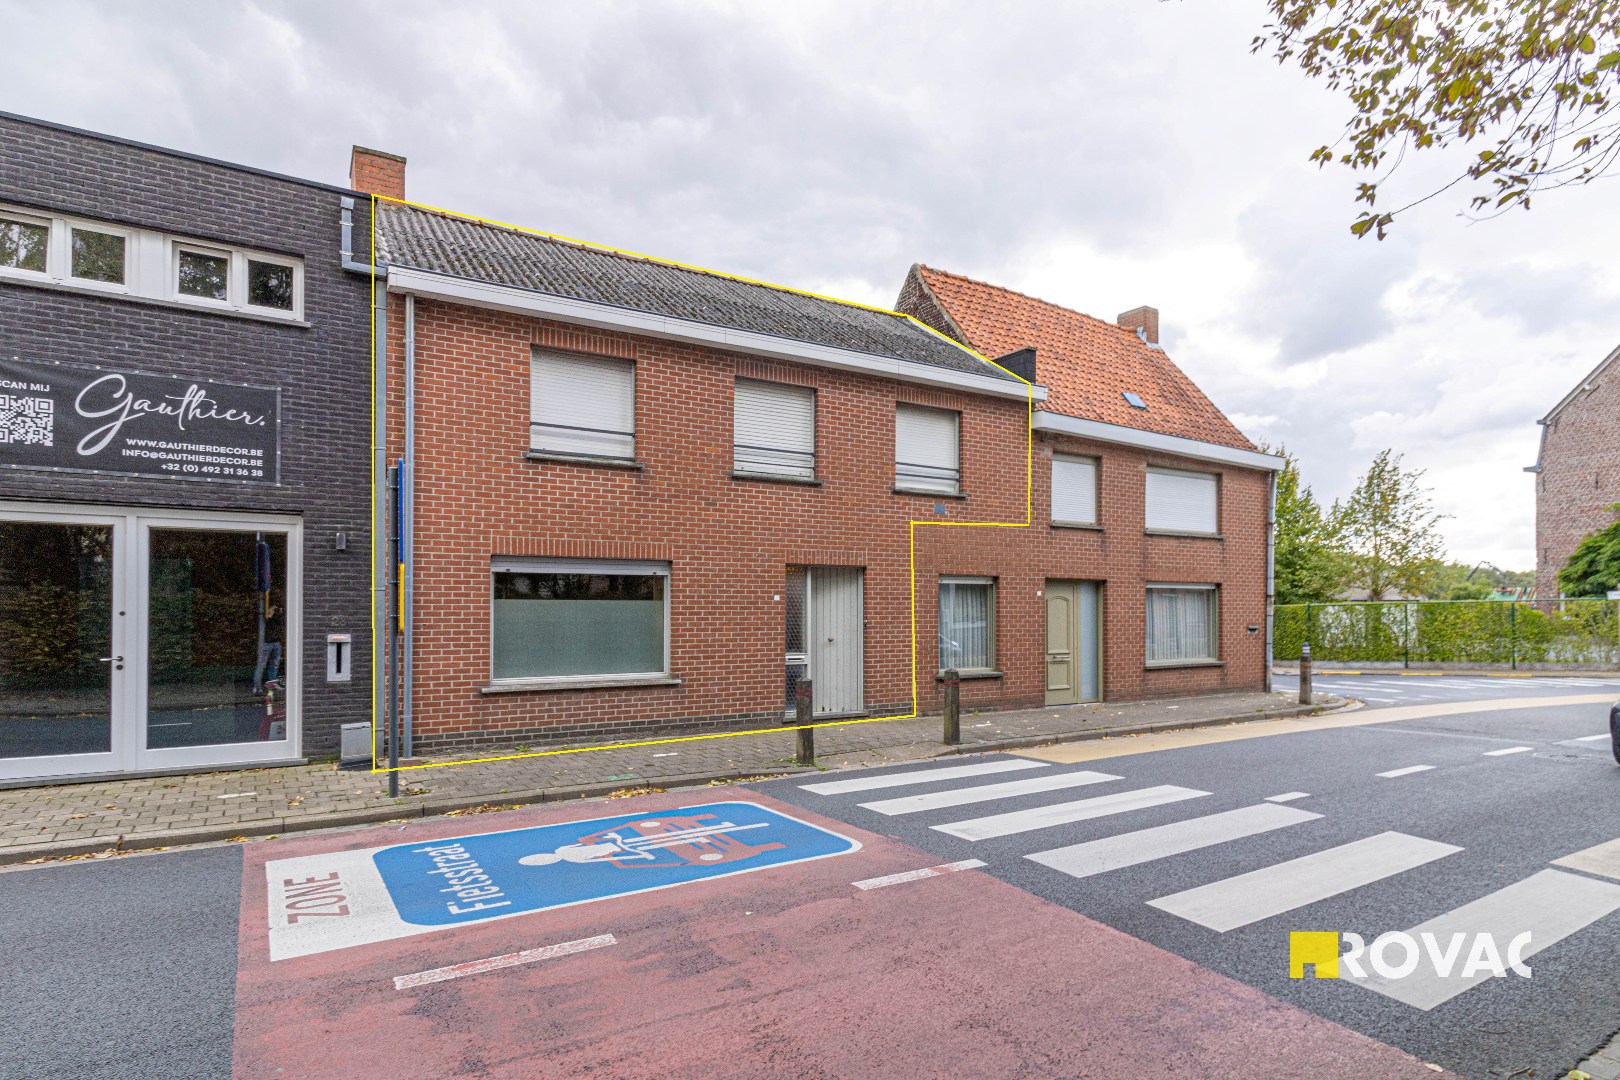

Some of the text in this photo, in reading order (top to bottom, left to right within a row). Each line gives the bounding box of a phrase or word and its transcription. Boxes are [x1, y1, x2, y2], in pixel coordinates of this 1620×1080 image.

[0, 380, 50, 392] CAN MIJ
[75, 374, 265, 455] Gauthier.
[126, 438, 263, 457] WWW.GAUTHIERDECOR.BE
[122, 449, 263, 467] INFO@GAUTHIERDECOR.BE
[161, 463, 180, 471] +32
[182, 464, 198, 473] (0)
[201, 466, 220, 474] 492
[223, 467, 234, 475] 31
[251, 469, 263, 477] 38
[413, 843, 512, 915] Fietsstraat
[284, 872, 350, 924] ZONE
